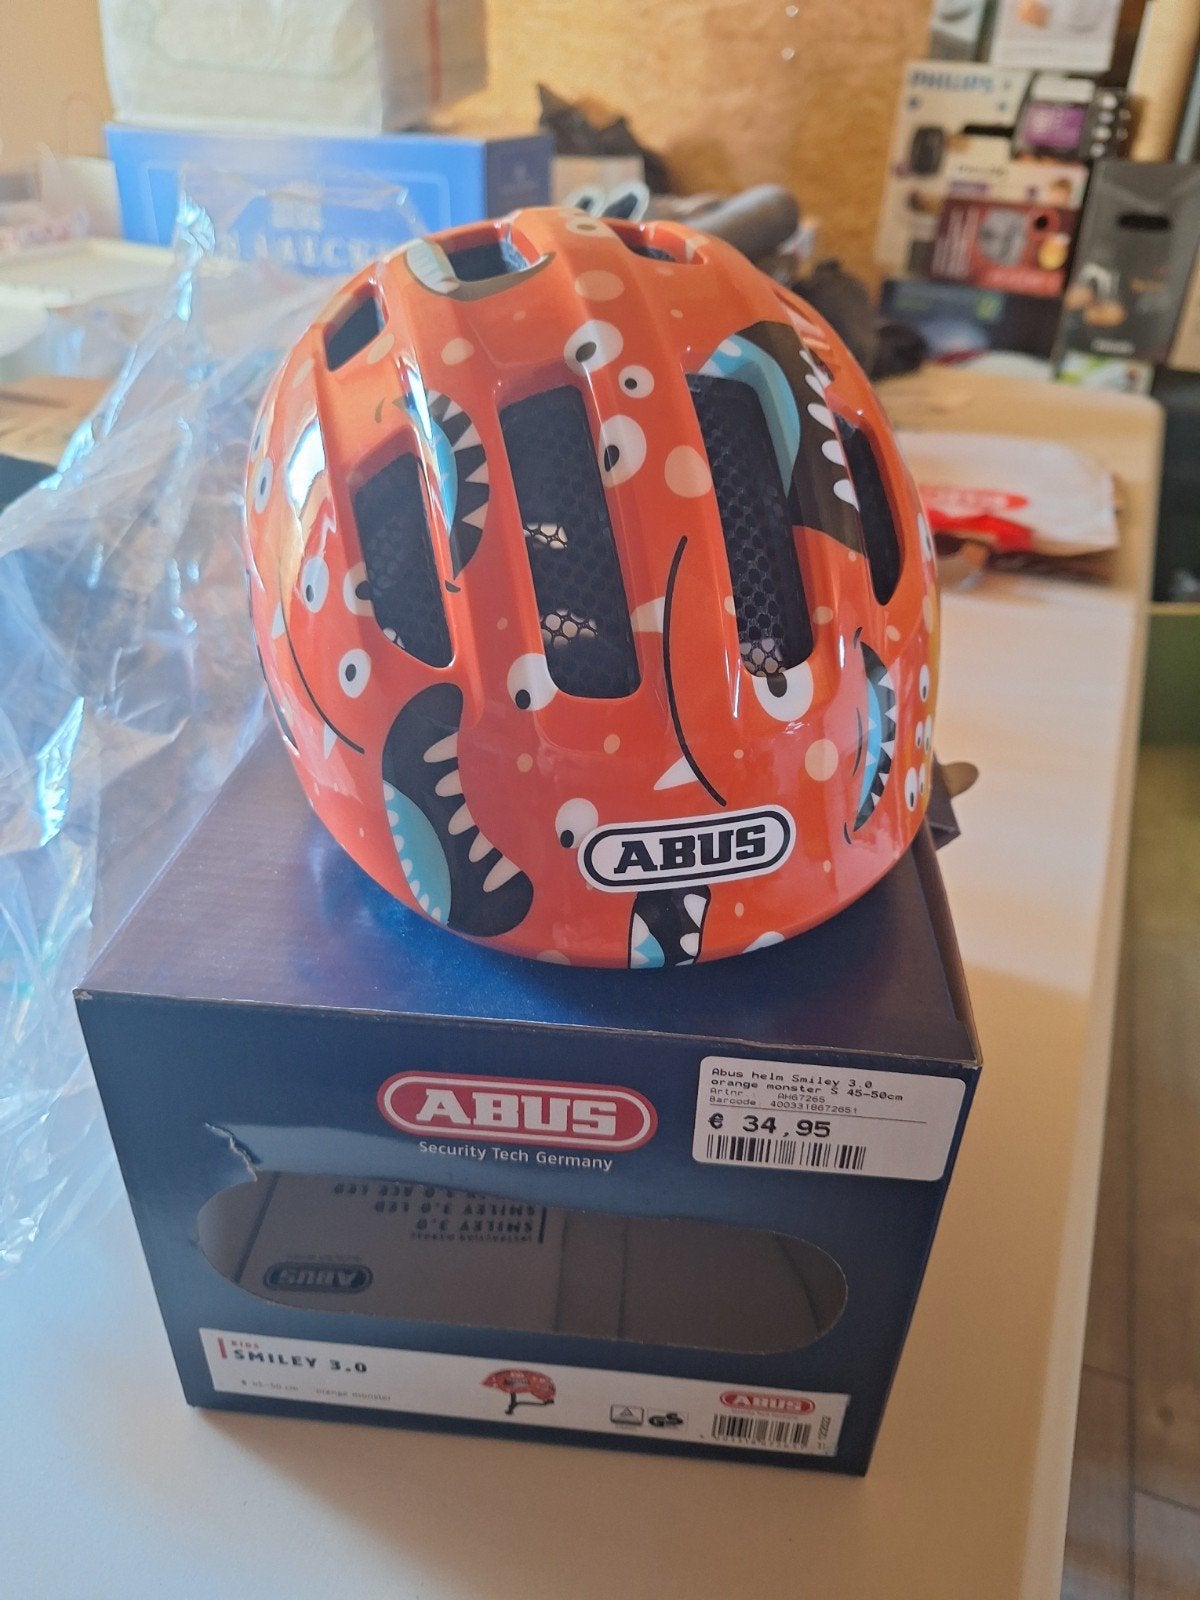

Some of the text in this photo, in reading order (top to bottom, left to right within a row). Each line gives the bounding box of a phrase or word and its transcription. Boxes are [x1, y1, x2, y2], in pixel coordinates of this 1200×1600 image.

[614, 824, 765, 874] ABUS
[711, 1067, 872, 1089] Abus helm Smiley 3.0
[711, 1079, 903, 1101] orange monster S 45-50cm
[416, 1088, 617, 1136] ABUS
[708, 1112, 831, 1138] € 34,95
[419, 1141, 613, 1172] Security Tech Germany
[234, 1349, 367, 1373] SMILEY 3.0
